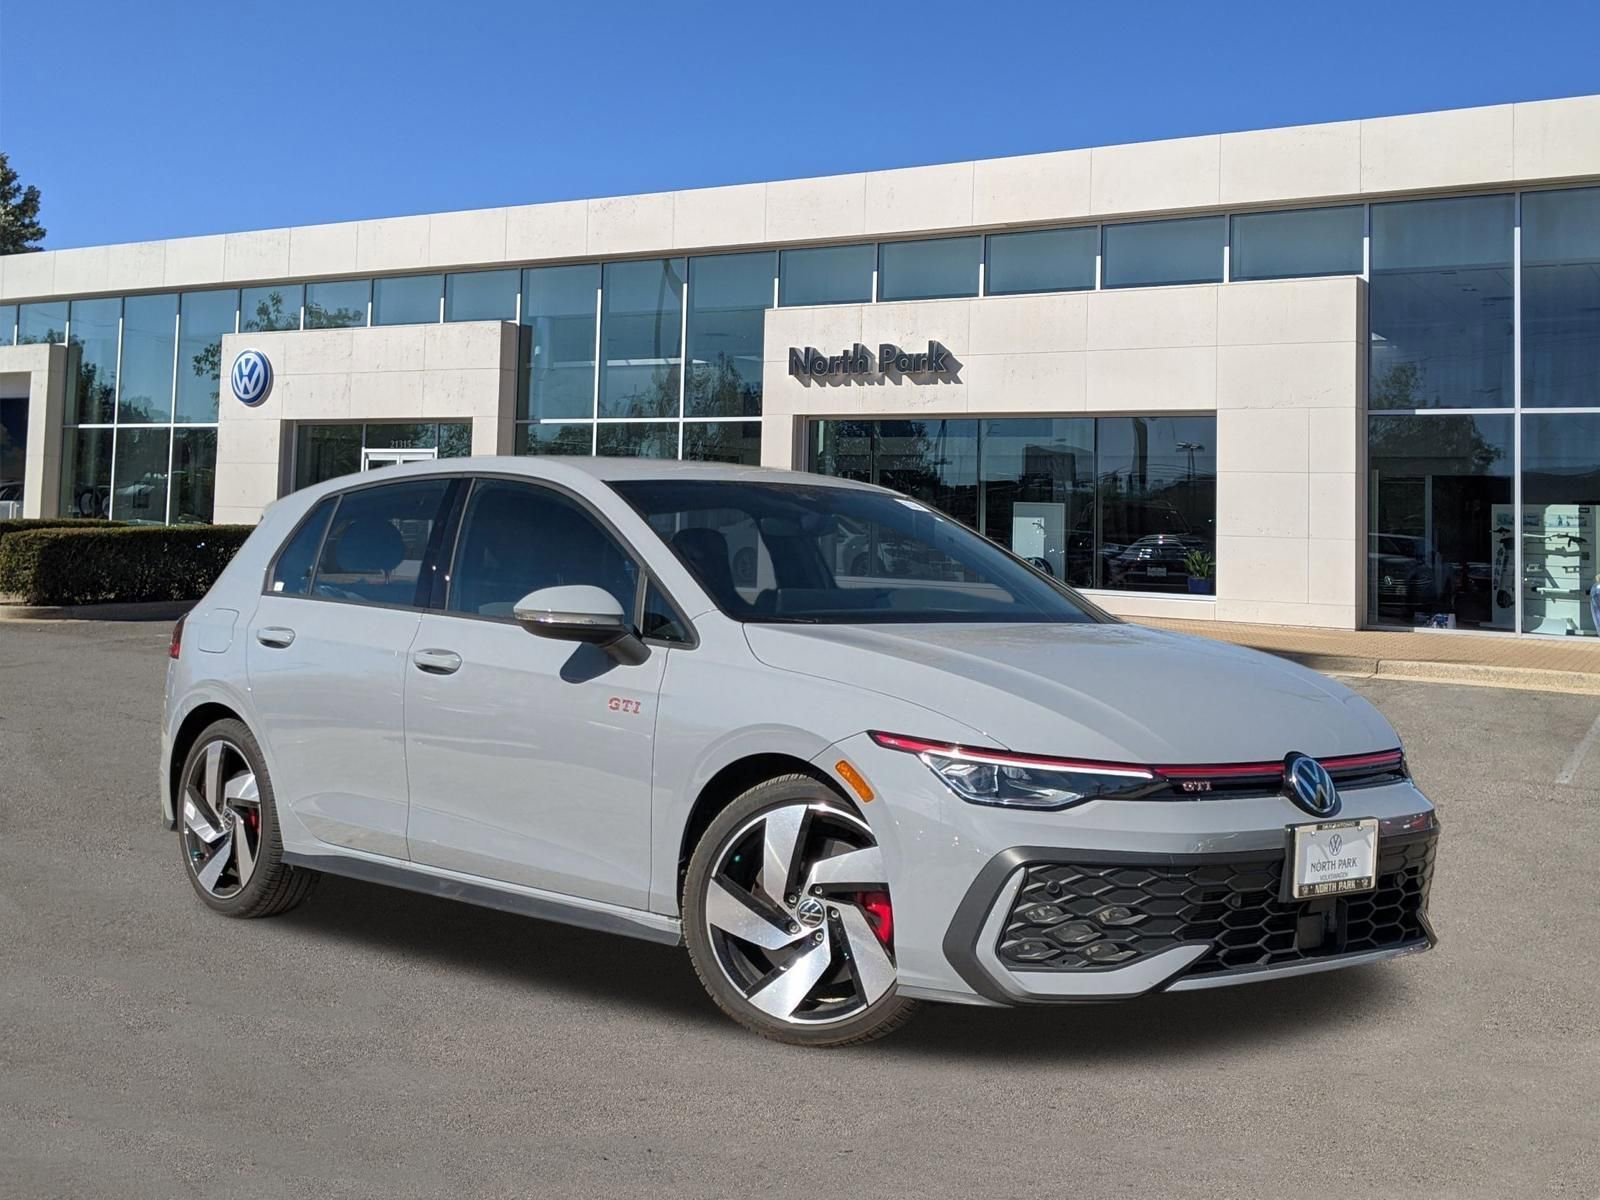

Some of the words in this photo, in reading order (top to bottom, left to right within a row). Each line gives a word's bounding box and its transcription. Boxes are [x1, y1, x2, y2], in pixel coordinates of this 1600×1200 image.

[789, 343, 870, 376] North
[878, 340, 949, 373] Park
[608, 697, 641, 714] GTI
[1182, 781, 1212, 792] GTI
[1310, 860, 1336, 873] NORTH
[1338, 857, 1358, 869] PARK
[1315, 882, 1337, 894] NORTH
[1338, 879, 1356, 890] PARK
